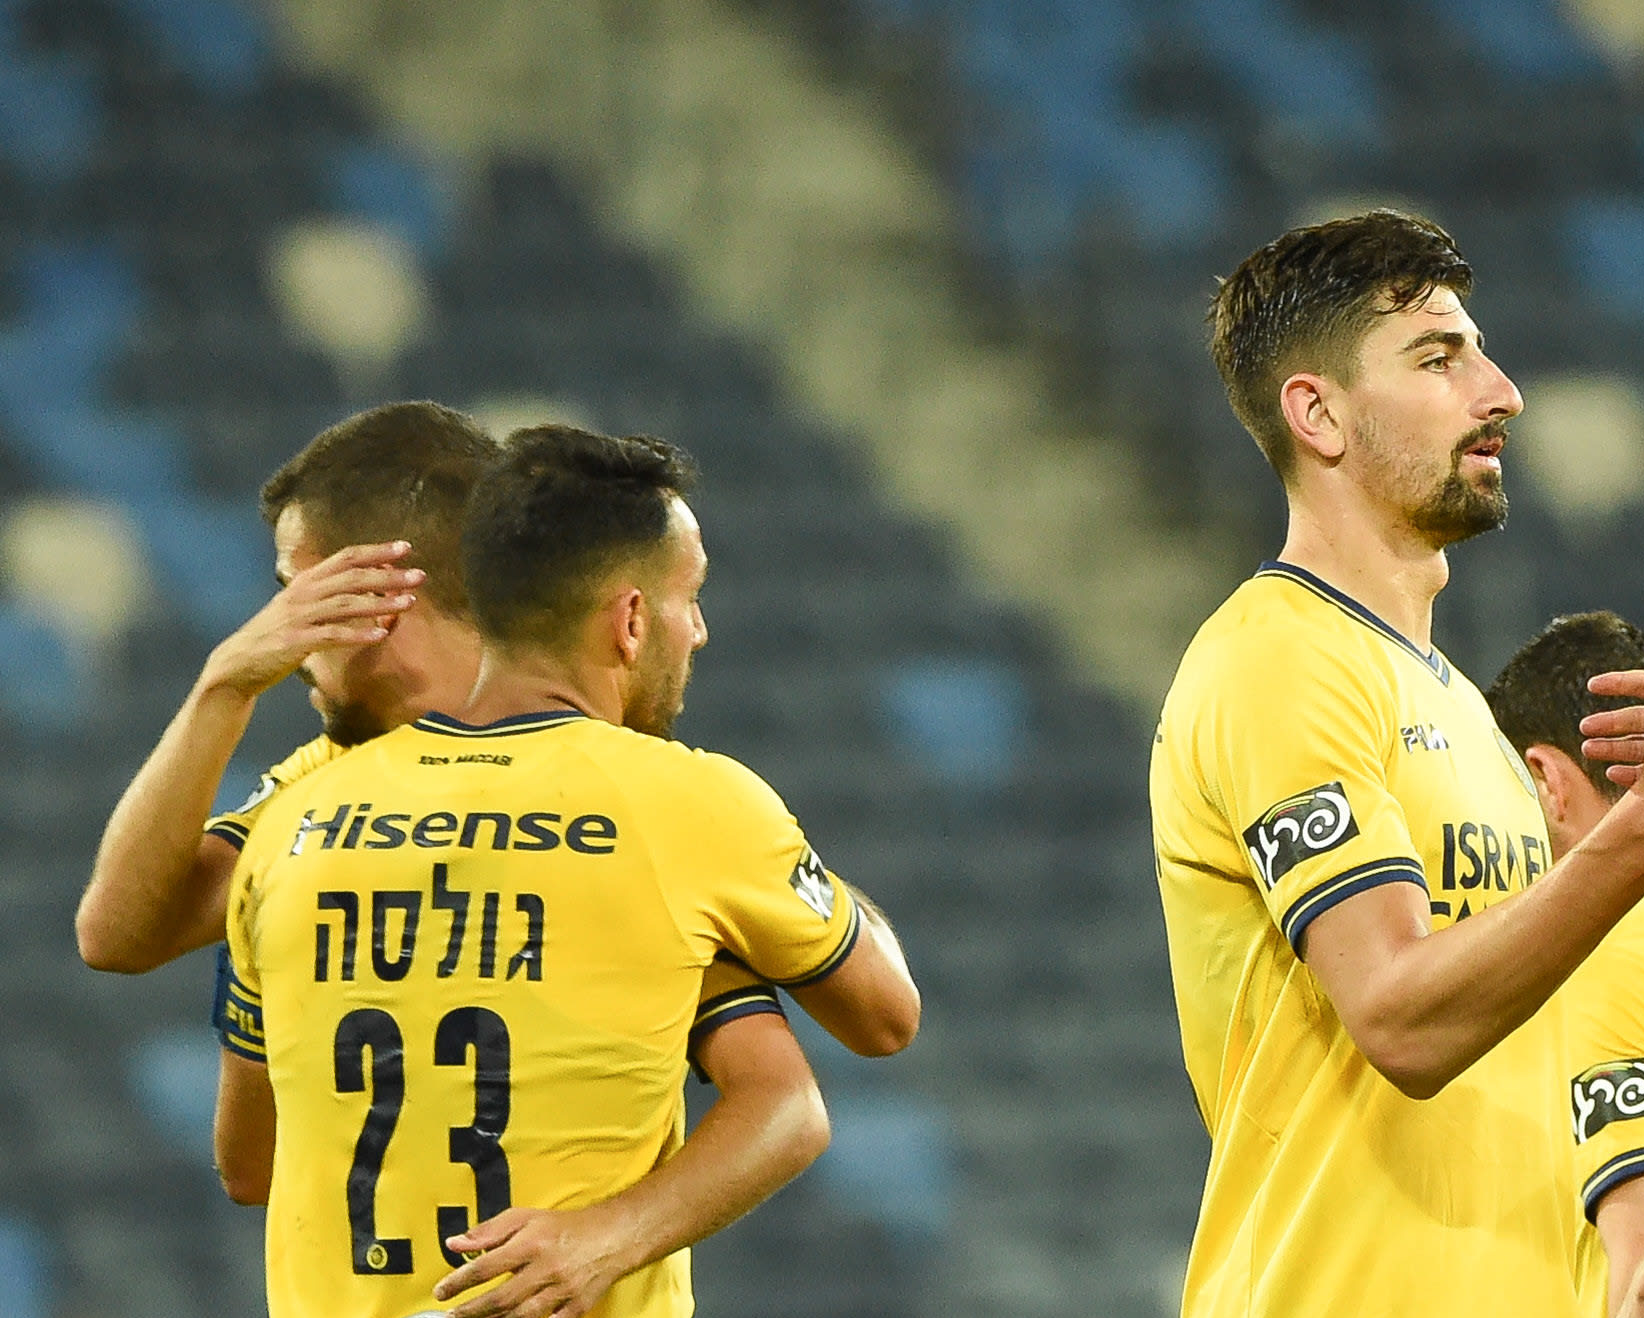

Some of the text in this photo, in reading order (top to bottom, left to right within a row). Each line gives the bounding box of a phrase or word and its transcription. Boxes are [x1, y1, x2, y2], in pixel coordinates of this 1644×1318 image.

[289, 803, 618, 857] Hisense
[313, 862, 545, 983] גולסה
[226, 998, 265, 1040] FIL
[333, 1006, 512, 1275] 23
